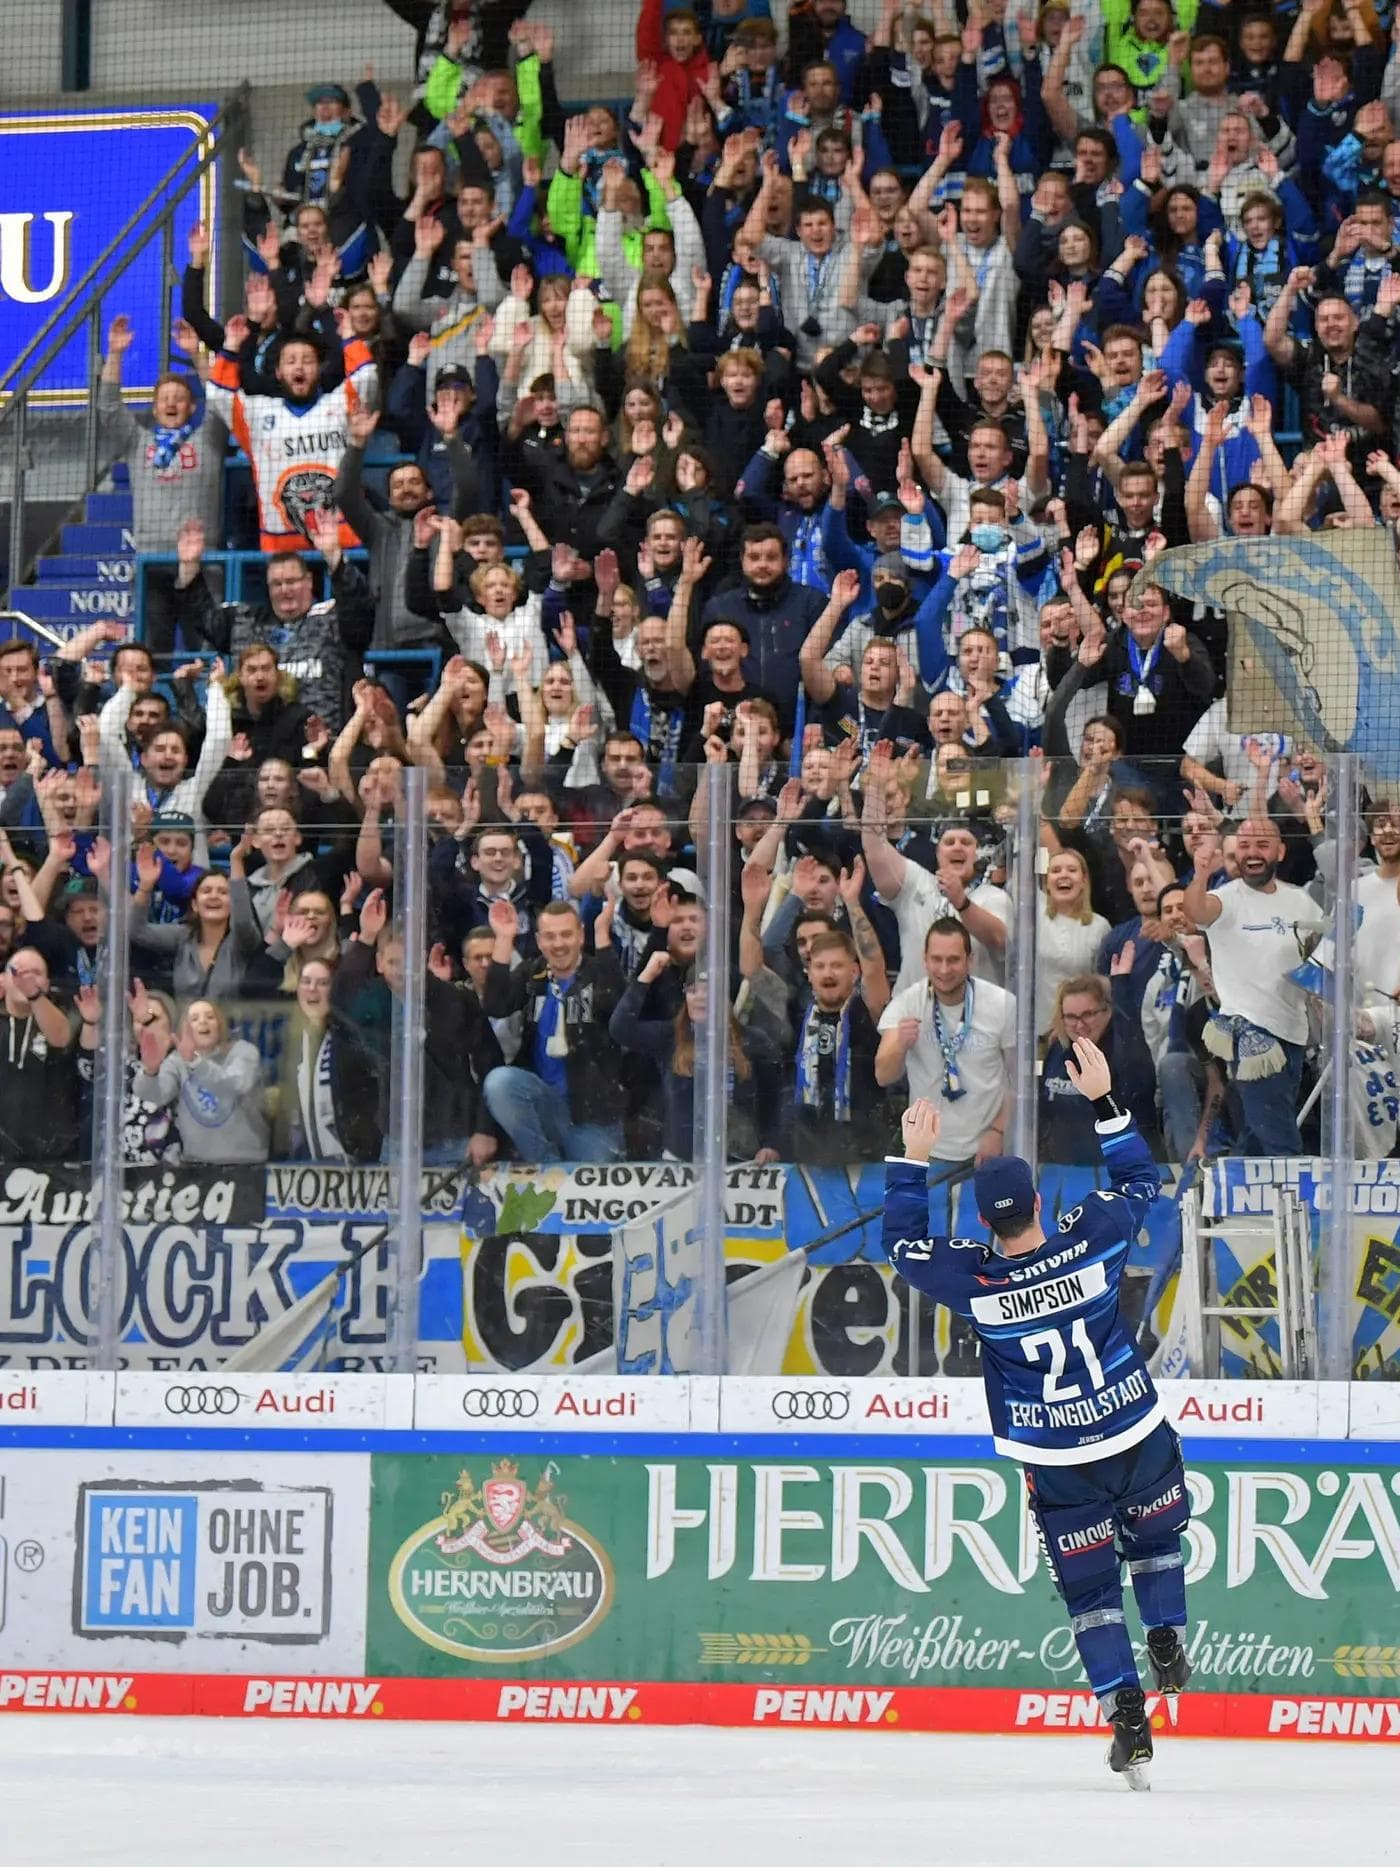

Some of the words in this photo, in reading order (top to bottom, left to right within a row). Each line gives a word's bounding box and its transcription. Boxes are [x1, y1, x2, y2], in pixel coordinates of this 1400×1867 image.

[574, 1166, 780, 1190] GIOVANTTI
[998, 1275, 1085, 1320] SIMPSON
[1020, 1317, 1106, 1404] 21
[254, 1388, 335, 1414] Audi
[555, 1391, 636, 1417] Audi
[866, 1394, 949, 1419] Audi
[1011, 1400, 1044, 1428] ERC
[1045, 1368, 1148, 1428] INGOLSTADT
[1177, 1397, 1263, 1423] Audi
[1127, 1483, 1182, 1518] CINQUE
[100, 1507, 183, 1555] KEIN
[208, 1508, 304, 1555] OHNE
[1057, 1517, 1115, 1553] CINQUE
[100, 1558, 180, 1616] FAN
[207, 1561, 312, 1618] JOB.
[411, 1569, 594, 1600] HERRNBRÄU
